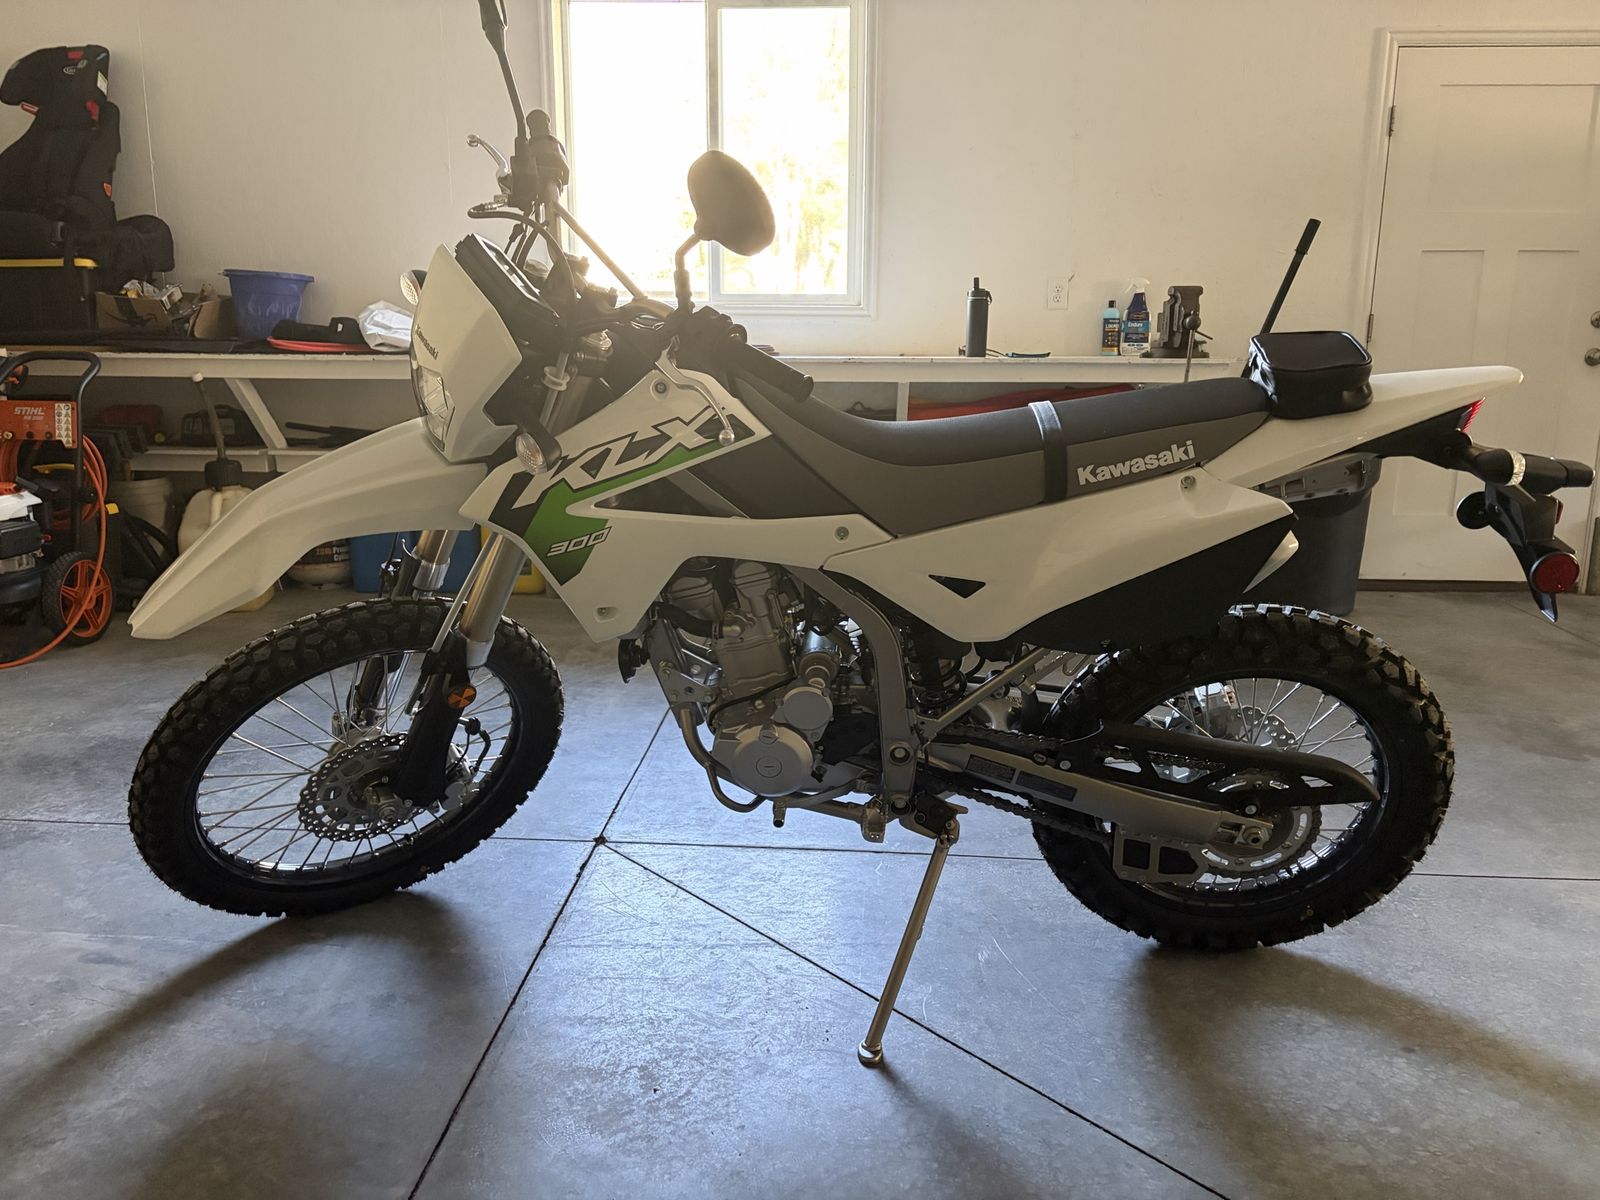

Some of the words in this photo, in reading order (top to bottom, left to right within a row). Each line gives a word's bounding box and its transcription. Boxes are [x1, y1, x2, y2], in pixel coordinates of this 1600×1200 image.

[416, 324, 439, 360] Kawasaki
[14, 406, 45, 415] STIHL
[1077, 440, 1196, 485] Kawasaki
[547, 526, 612, 556] 300
